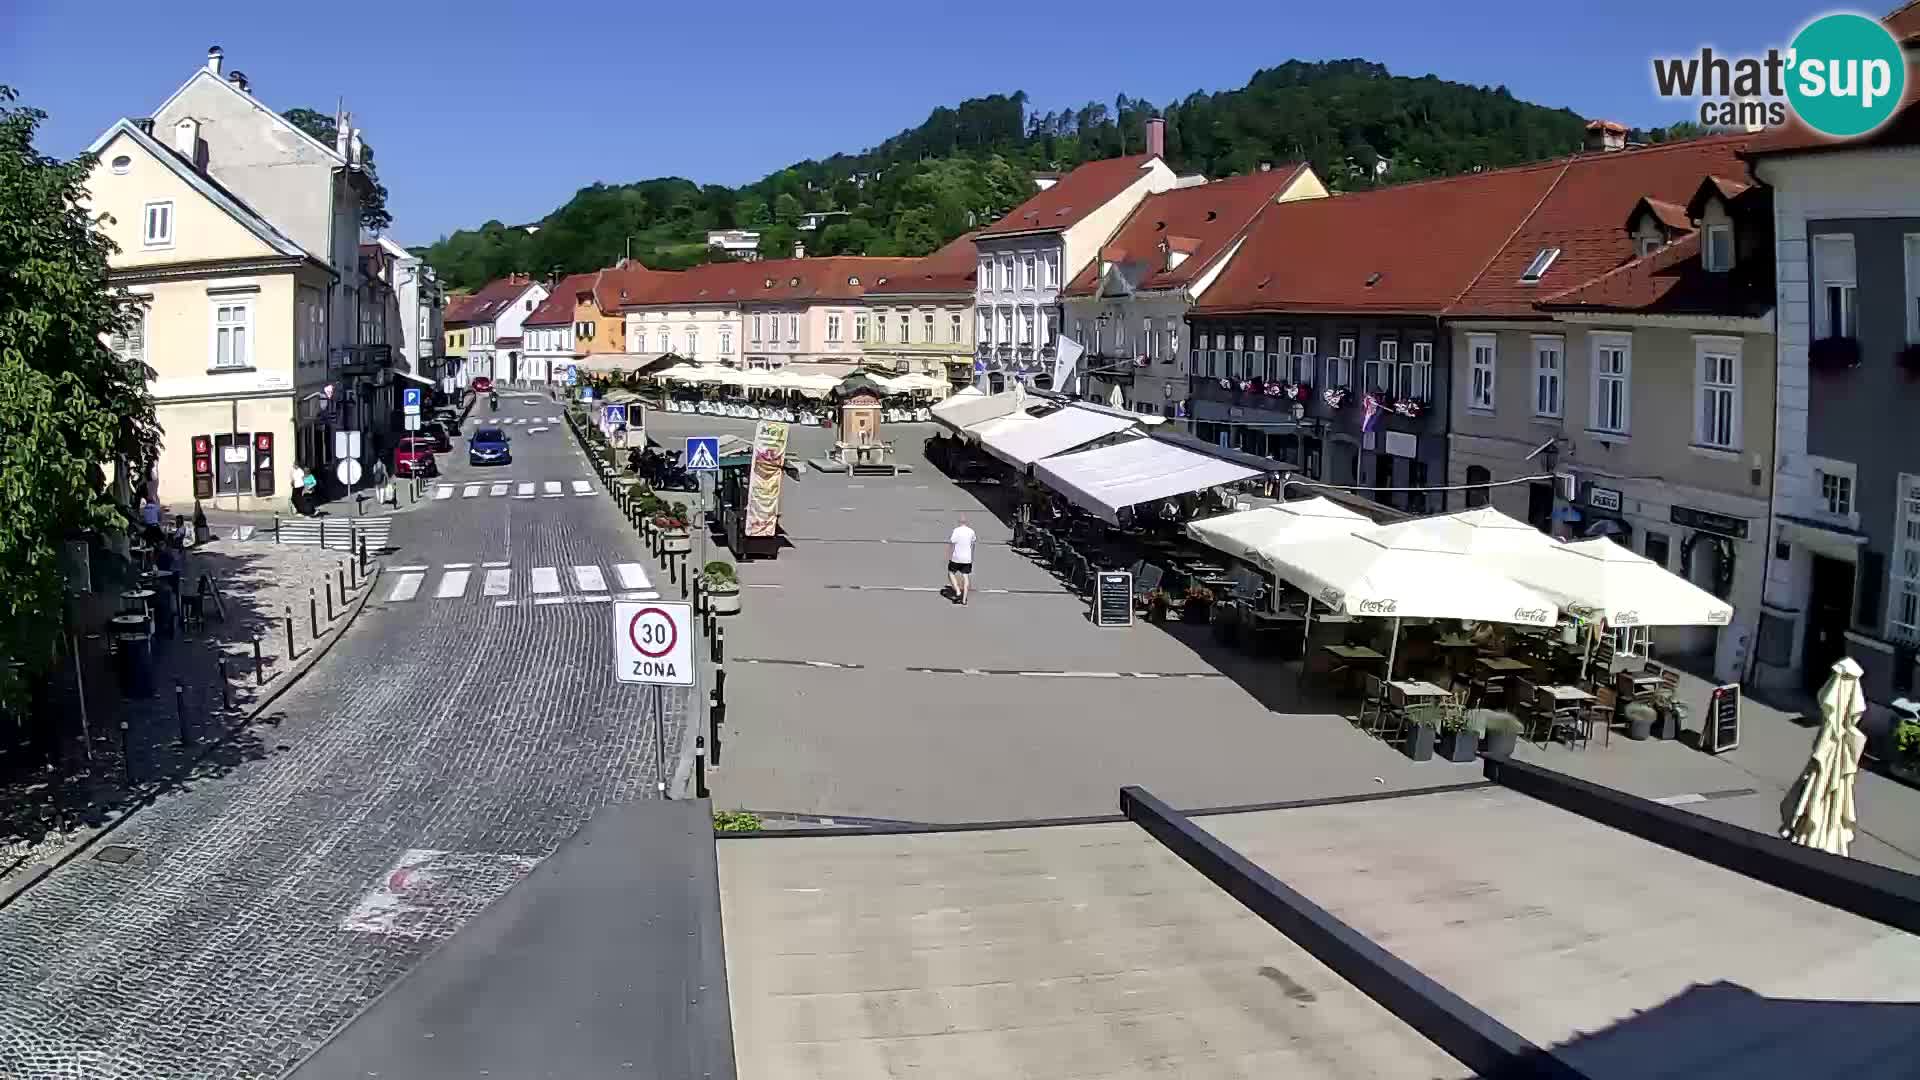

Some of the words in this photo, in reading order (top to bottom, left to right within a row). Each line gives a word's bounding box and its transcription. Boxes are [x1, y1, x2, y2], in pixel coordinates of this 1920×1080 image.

[408, 391, 417, 404] P
[642, 623, 666, 644] 30
[632, 660, 676, 677] ZONA
